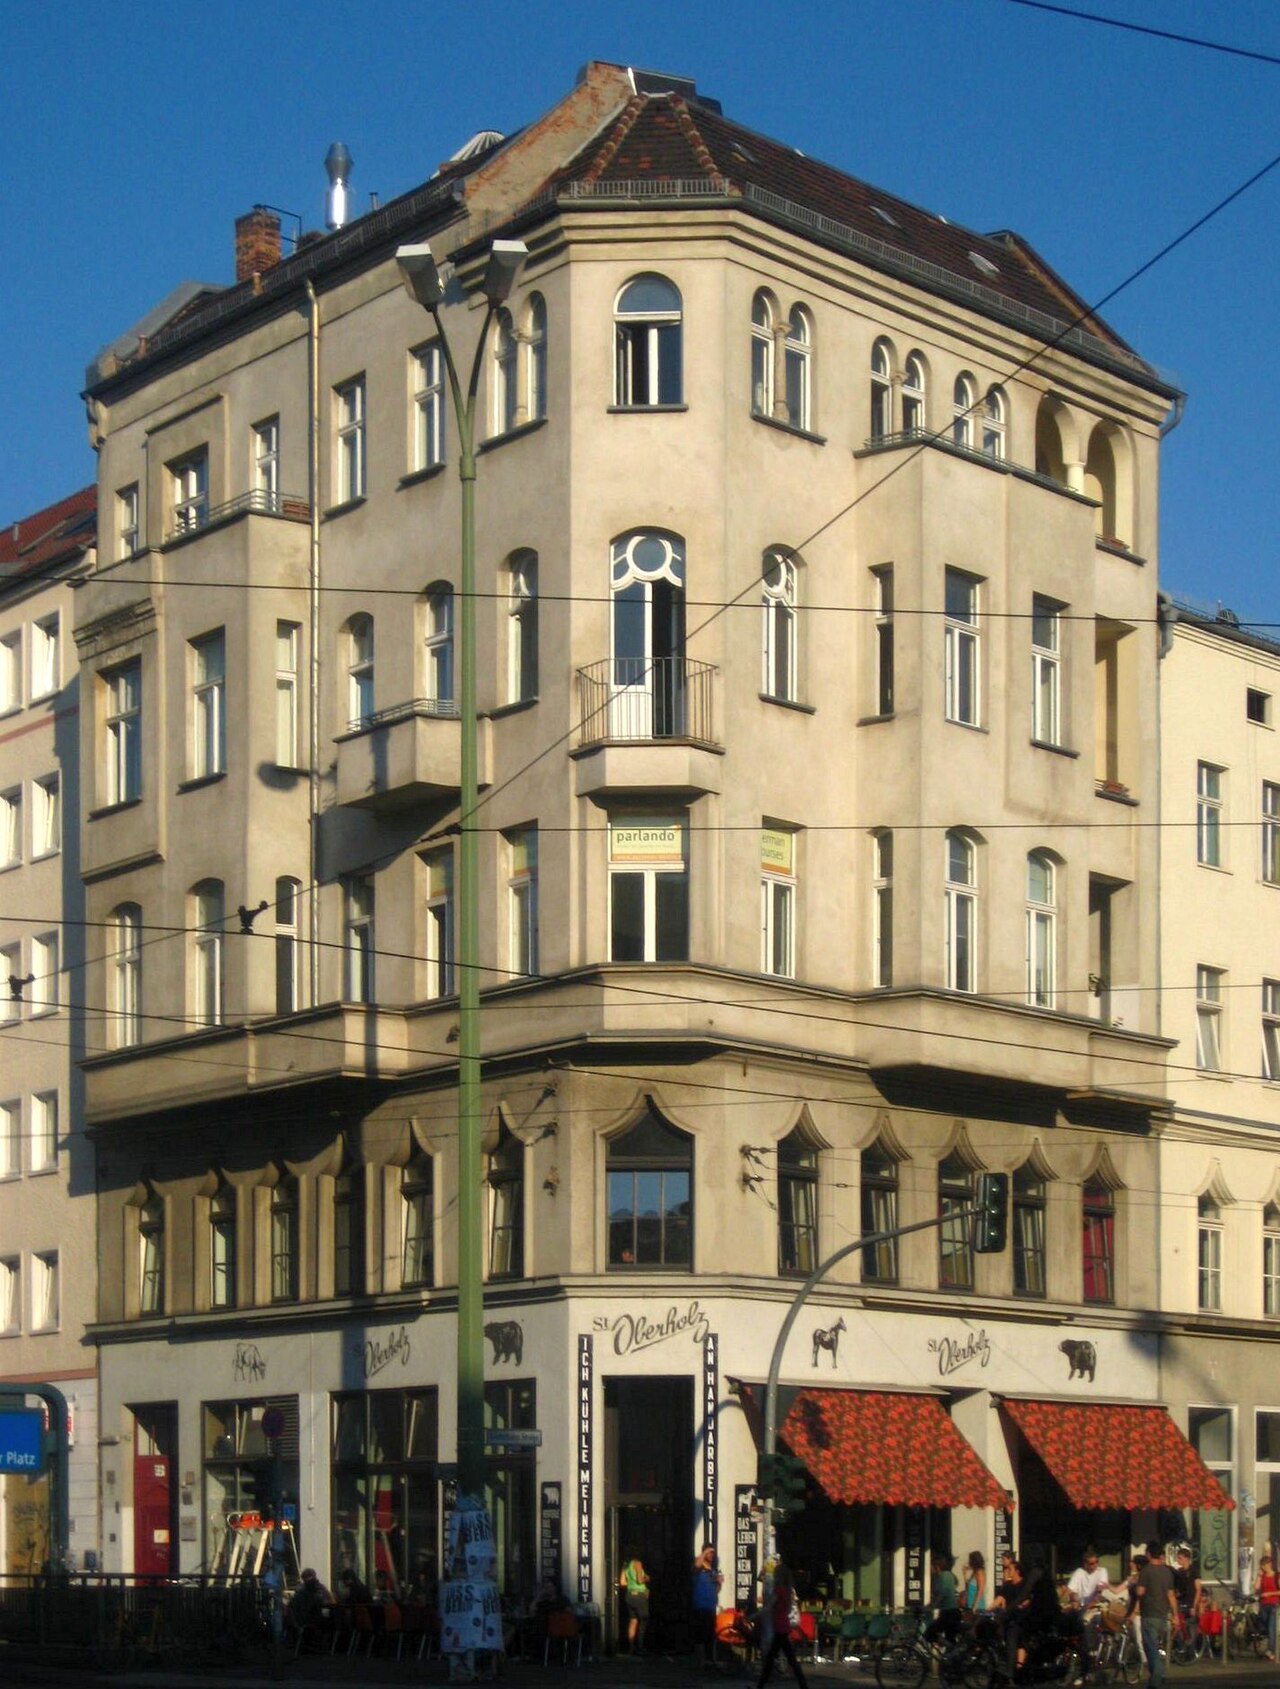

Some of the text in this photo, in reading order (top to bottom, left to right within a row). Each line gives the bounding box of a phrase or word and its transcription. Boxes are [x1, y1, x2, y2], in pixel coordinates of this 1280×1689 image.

[617, 829, 675, 843] parlando
[762, 835, 786, 848] erman
[611, 1301, 710, 1355] Oberholz
[581, 1337, 589, 1381] ICH
[938, 1329, 990, 1375] Oberholz
[7, 1452, 35, 1465] Platz
[580, 1472, 591, 1558] MEINEN
